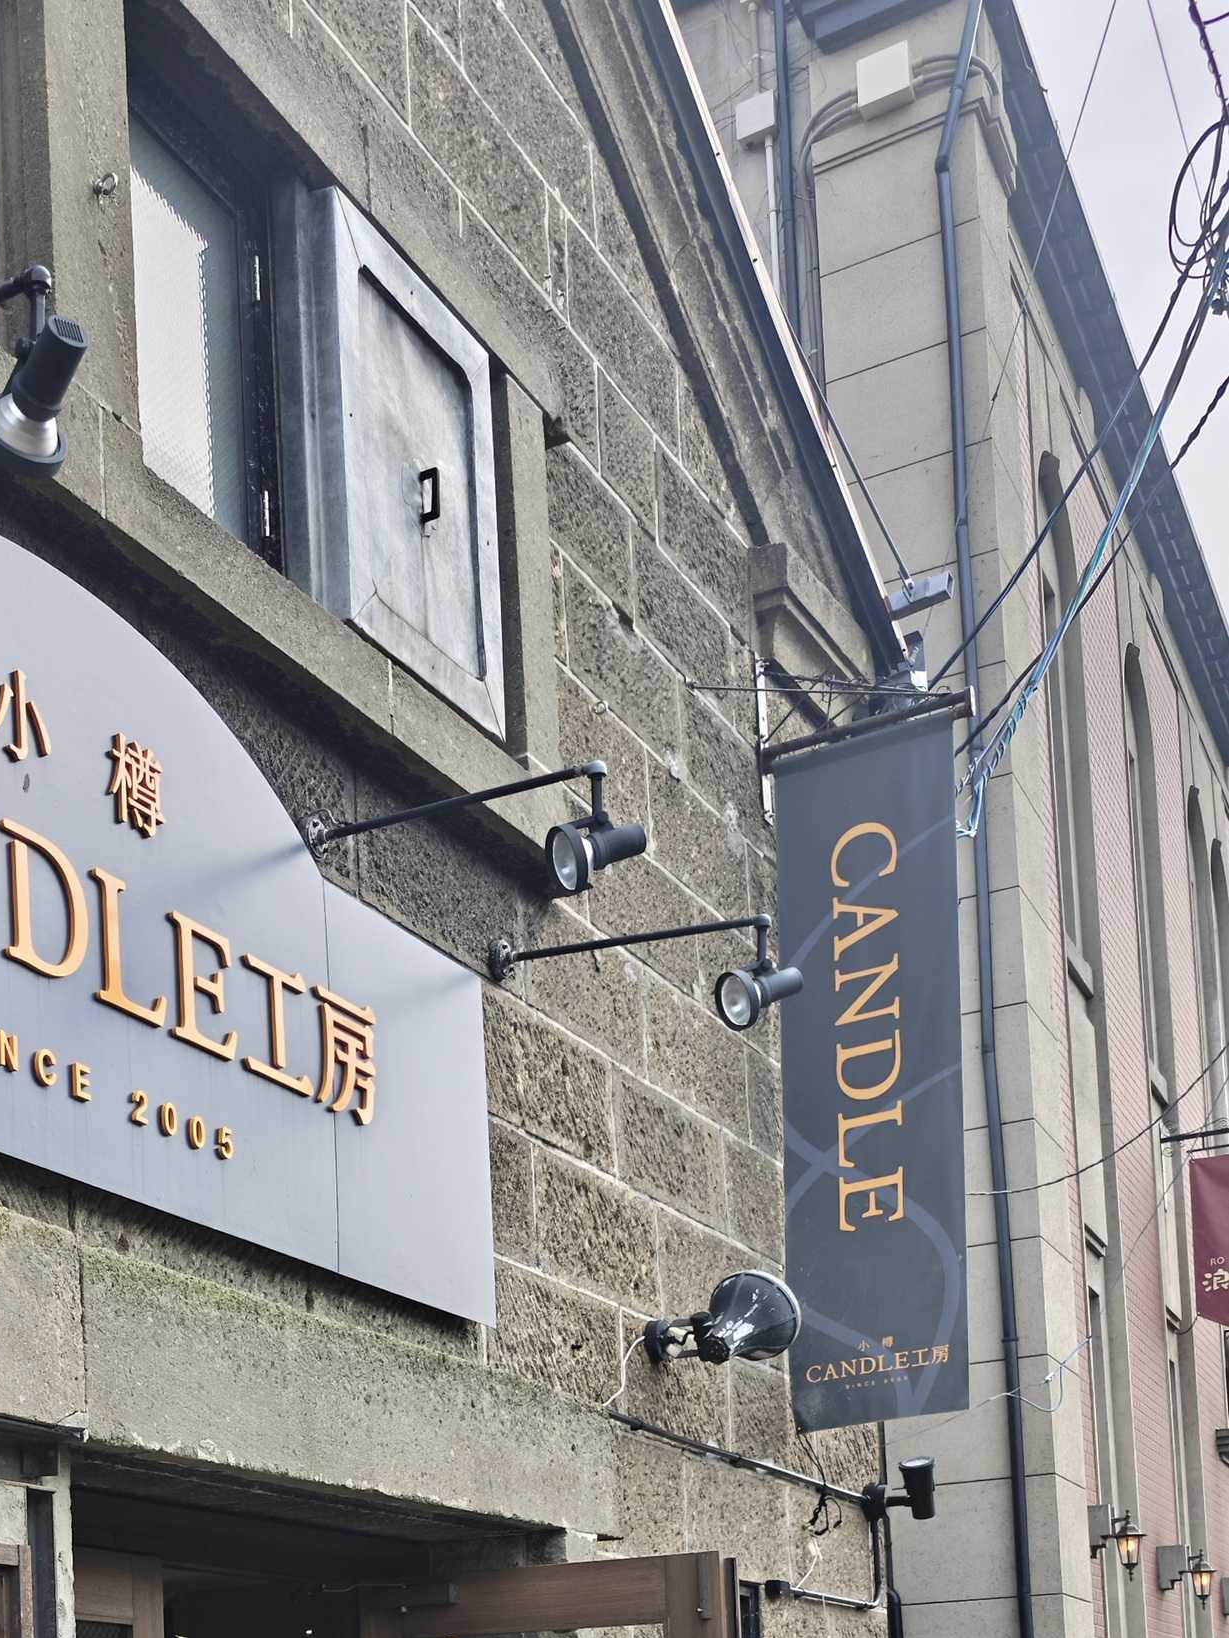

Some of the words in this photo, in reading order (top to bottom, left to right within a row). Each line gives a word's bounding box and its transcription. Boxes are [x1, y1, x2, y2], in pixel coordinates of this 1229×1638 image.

[830, 821, 904, 1232] CANDLE
[130, 1089, 236, 1161] 2005
[805, 1344, 950, 1384] CANDLE工房
